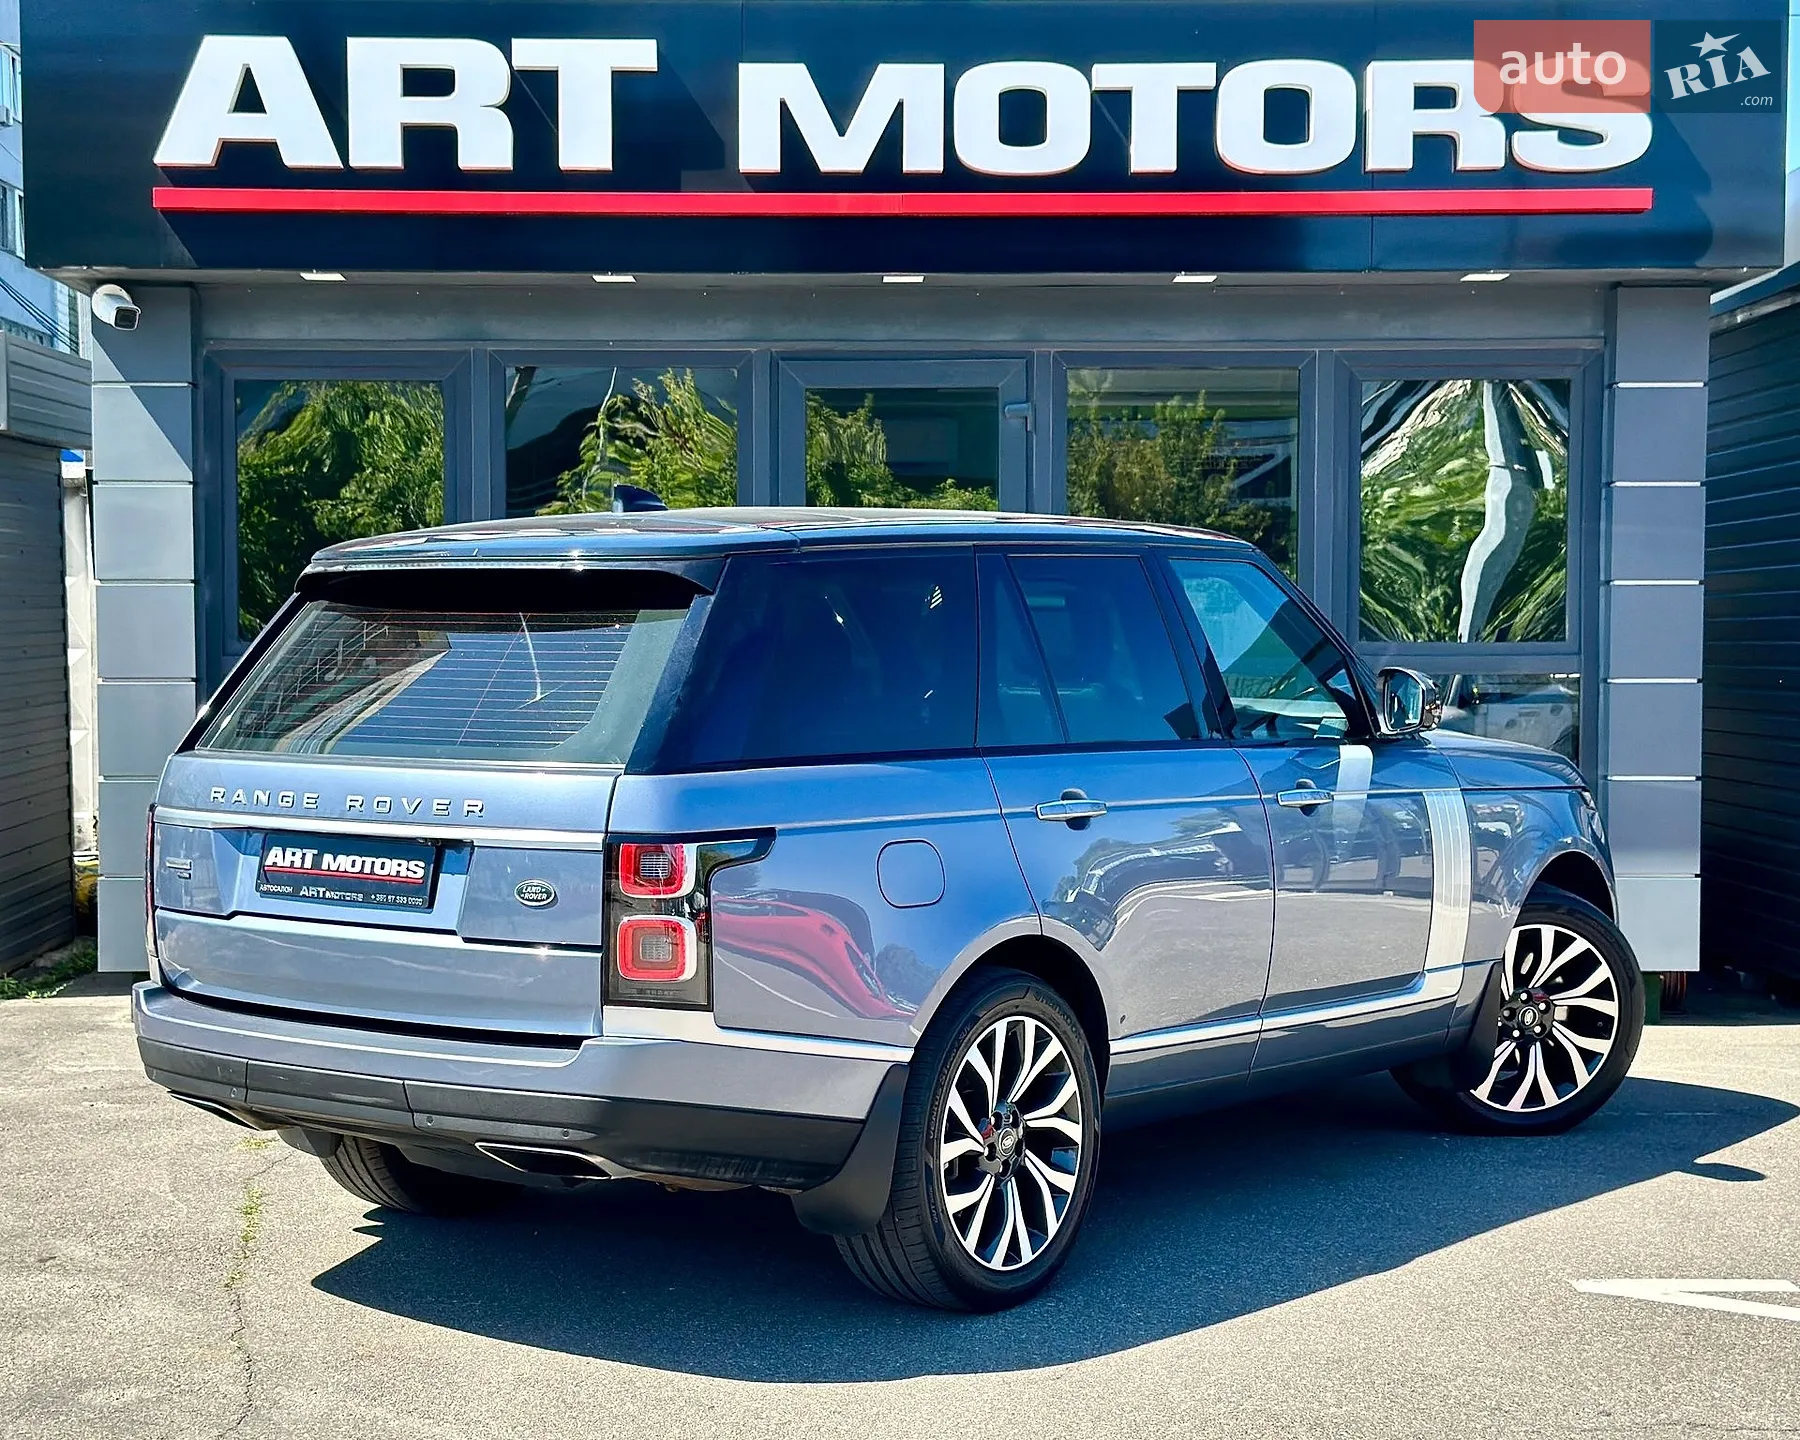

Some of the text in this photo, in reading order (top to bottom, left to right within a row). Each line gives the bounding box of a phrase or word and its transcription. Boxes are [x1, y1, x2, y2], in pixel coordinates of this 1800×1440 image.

[153, 35, 1653, 173] ART MOTORS
[210, 786, 485, 818] RANGE ROVER
[264, 846, 426, 879] ART MOTORS
[524, 892, 547, 900] ROVER
